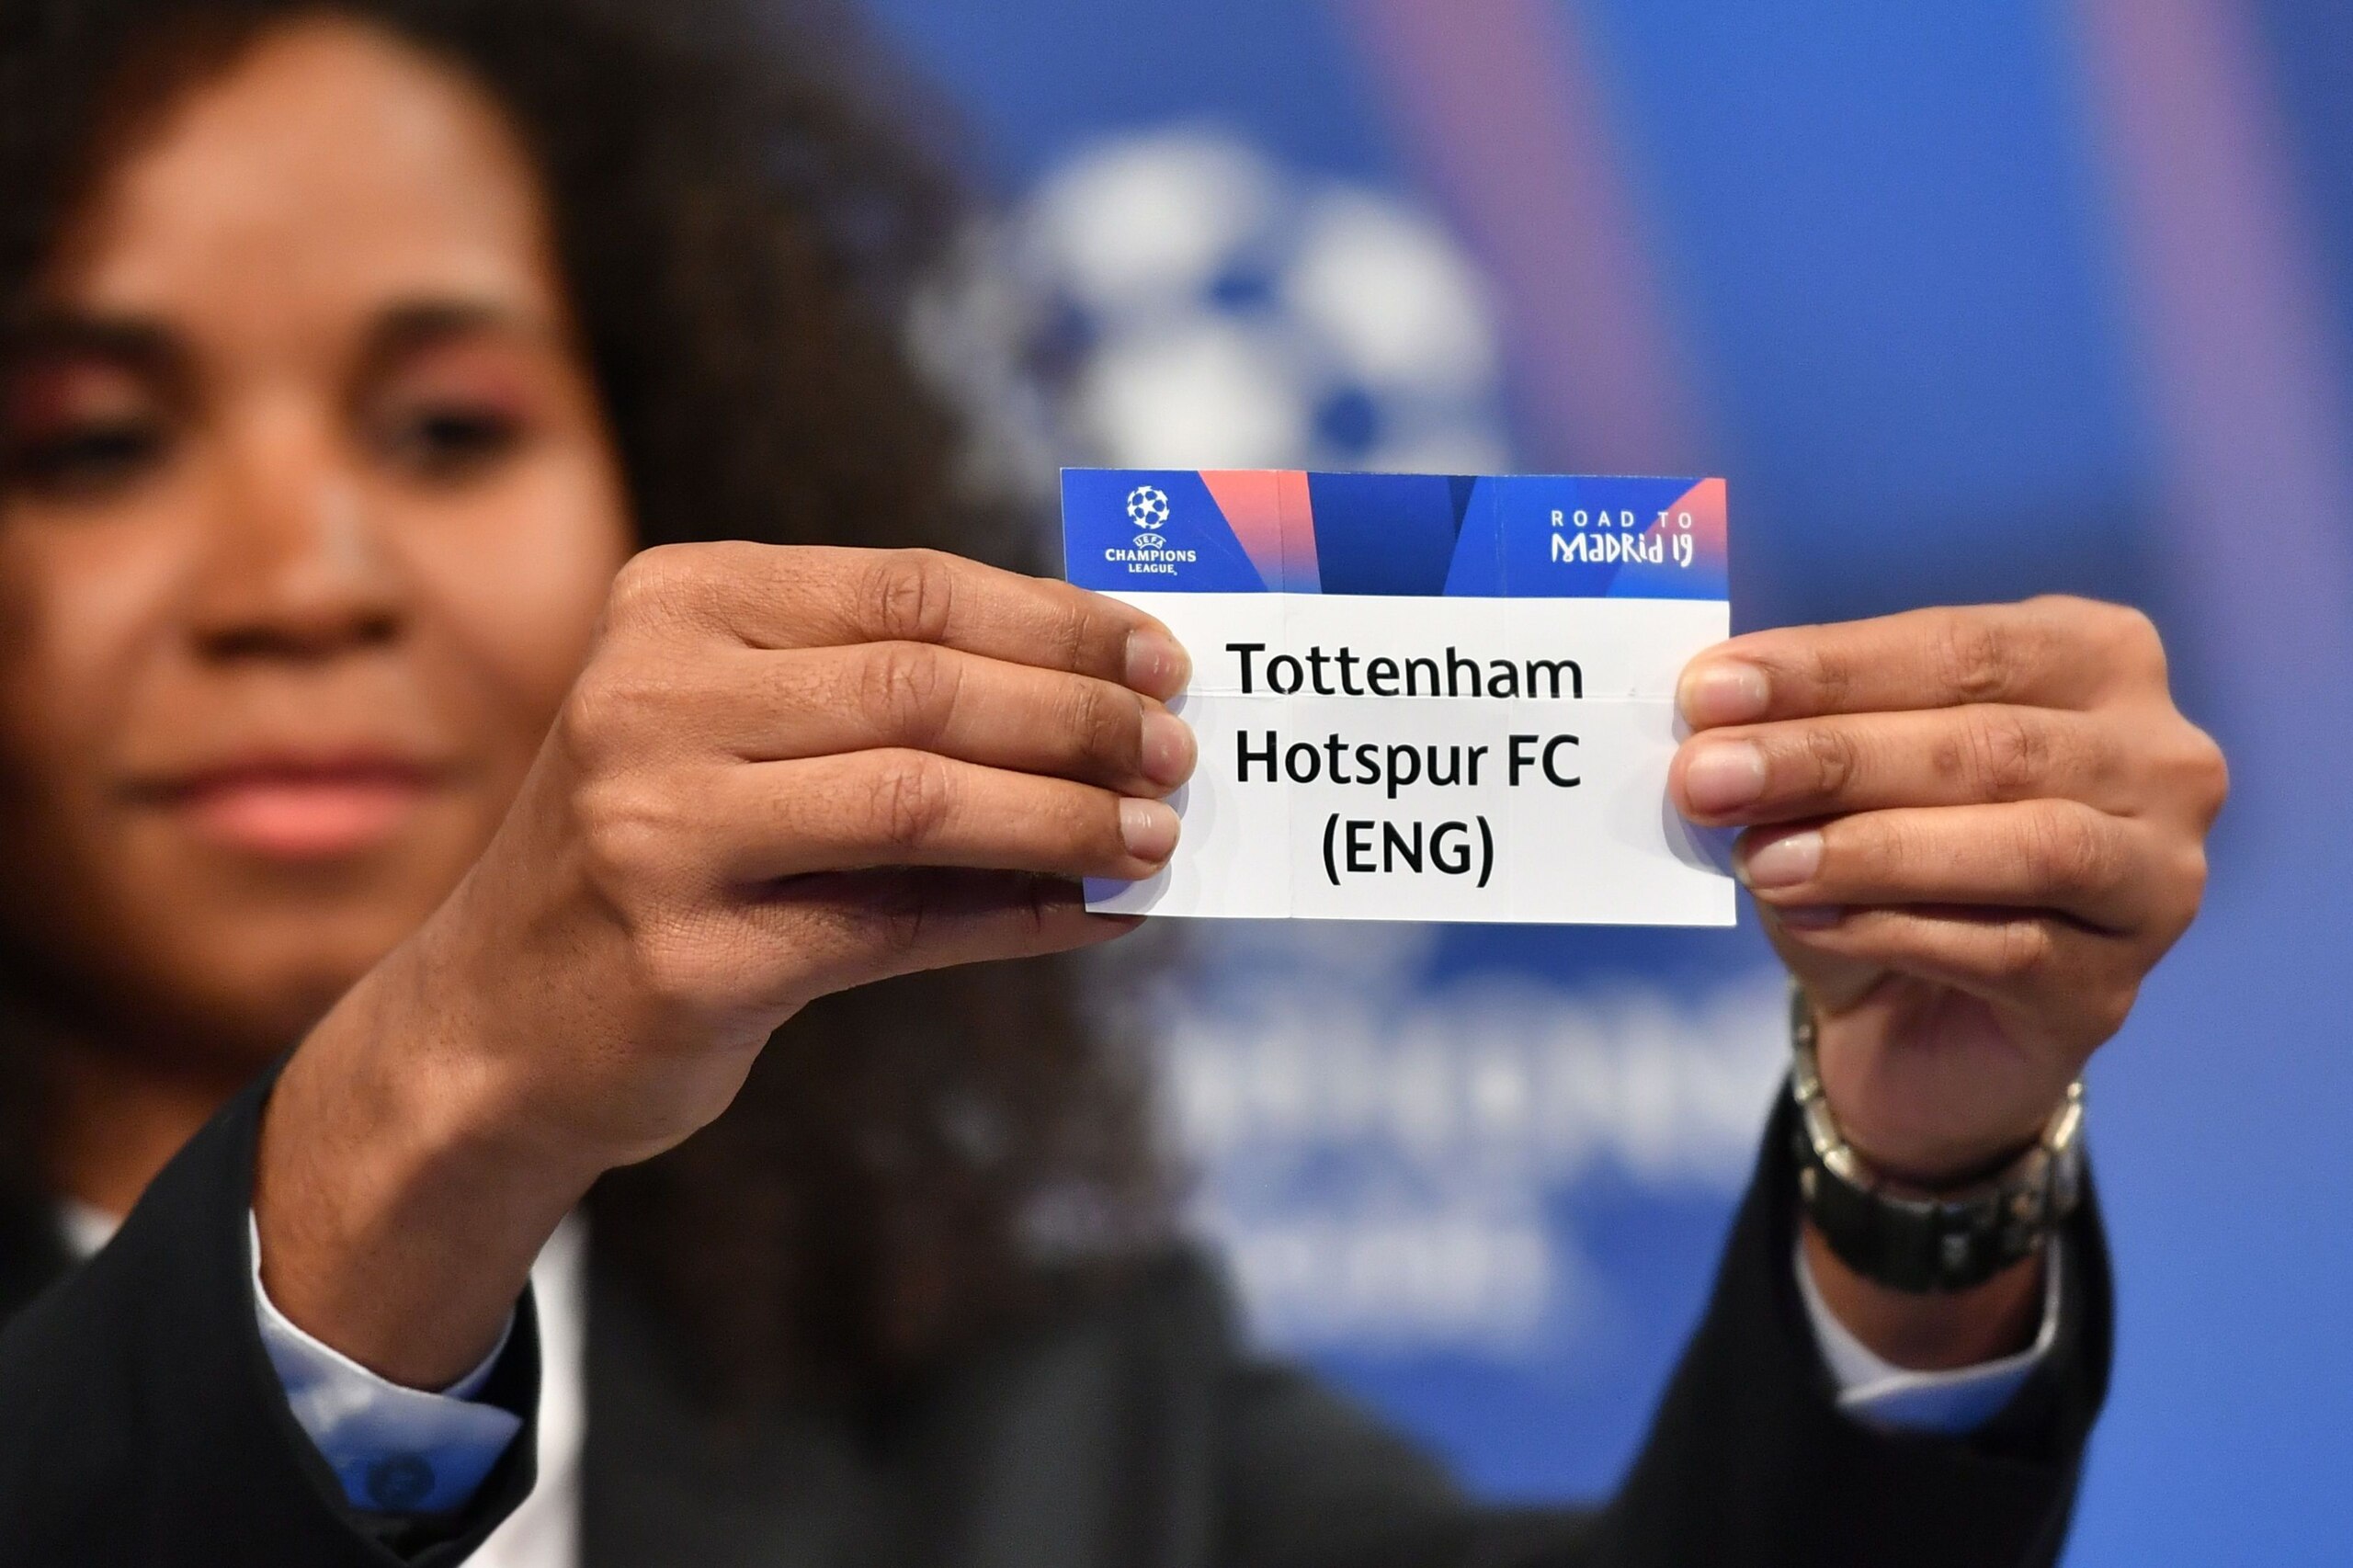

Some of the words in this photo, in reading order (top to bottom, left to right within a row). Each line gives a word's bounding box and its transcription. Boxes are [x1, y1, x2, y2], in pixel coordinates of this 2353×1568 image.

[1551, 509, 1635, 528] ROAD
[1657, 511, 1692, 529] TO
[1105, 548, 1197, 562] CHAMPIONS
[1133, 534, 1165, 549] UEFA
[1672, 533, 1693, 569] 19
[1129, 562, 1175, 574] LEAGUE
[1225, 642, 1583, 699] Tottenham
[1236, 730, 1489, 800] Hotspur
[1508, 734, 1581, 788] FC
[1323, 812, 1494, 889] (ENG)
